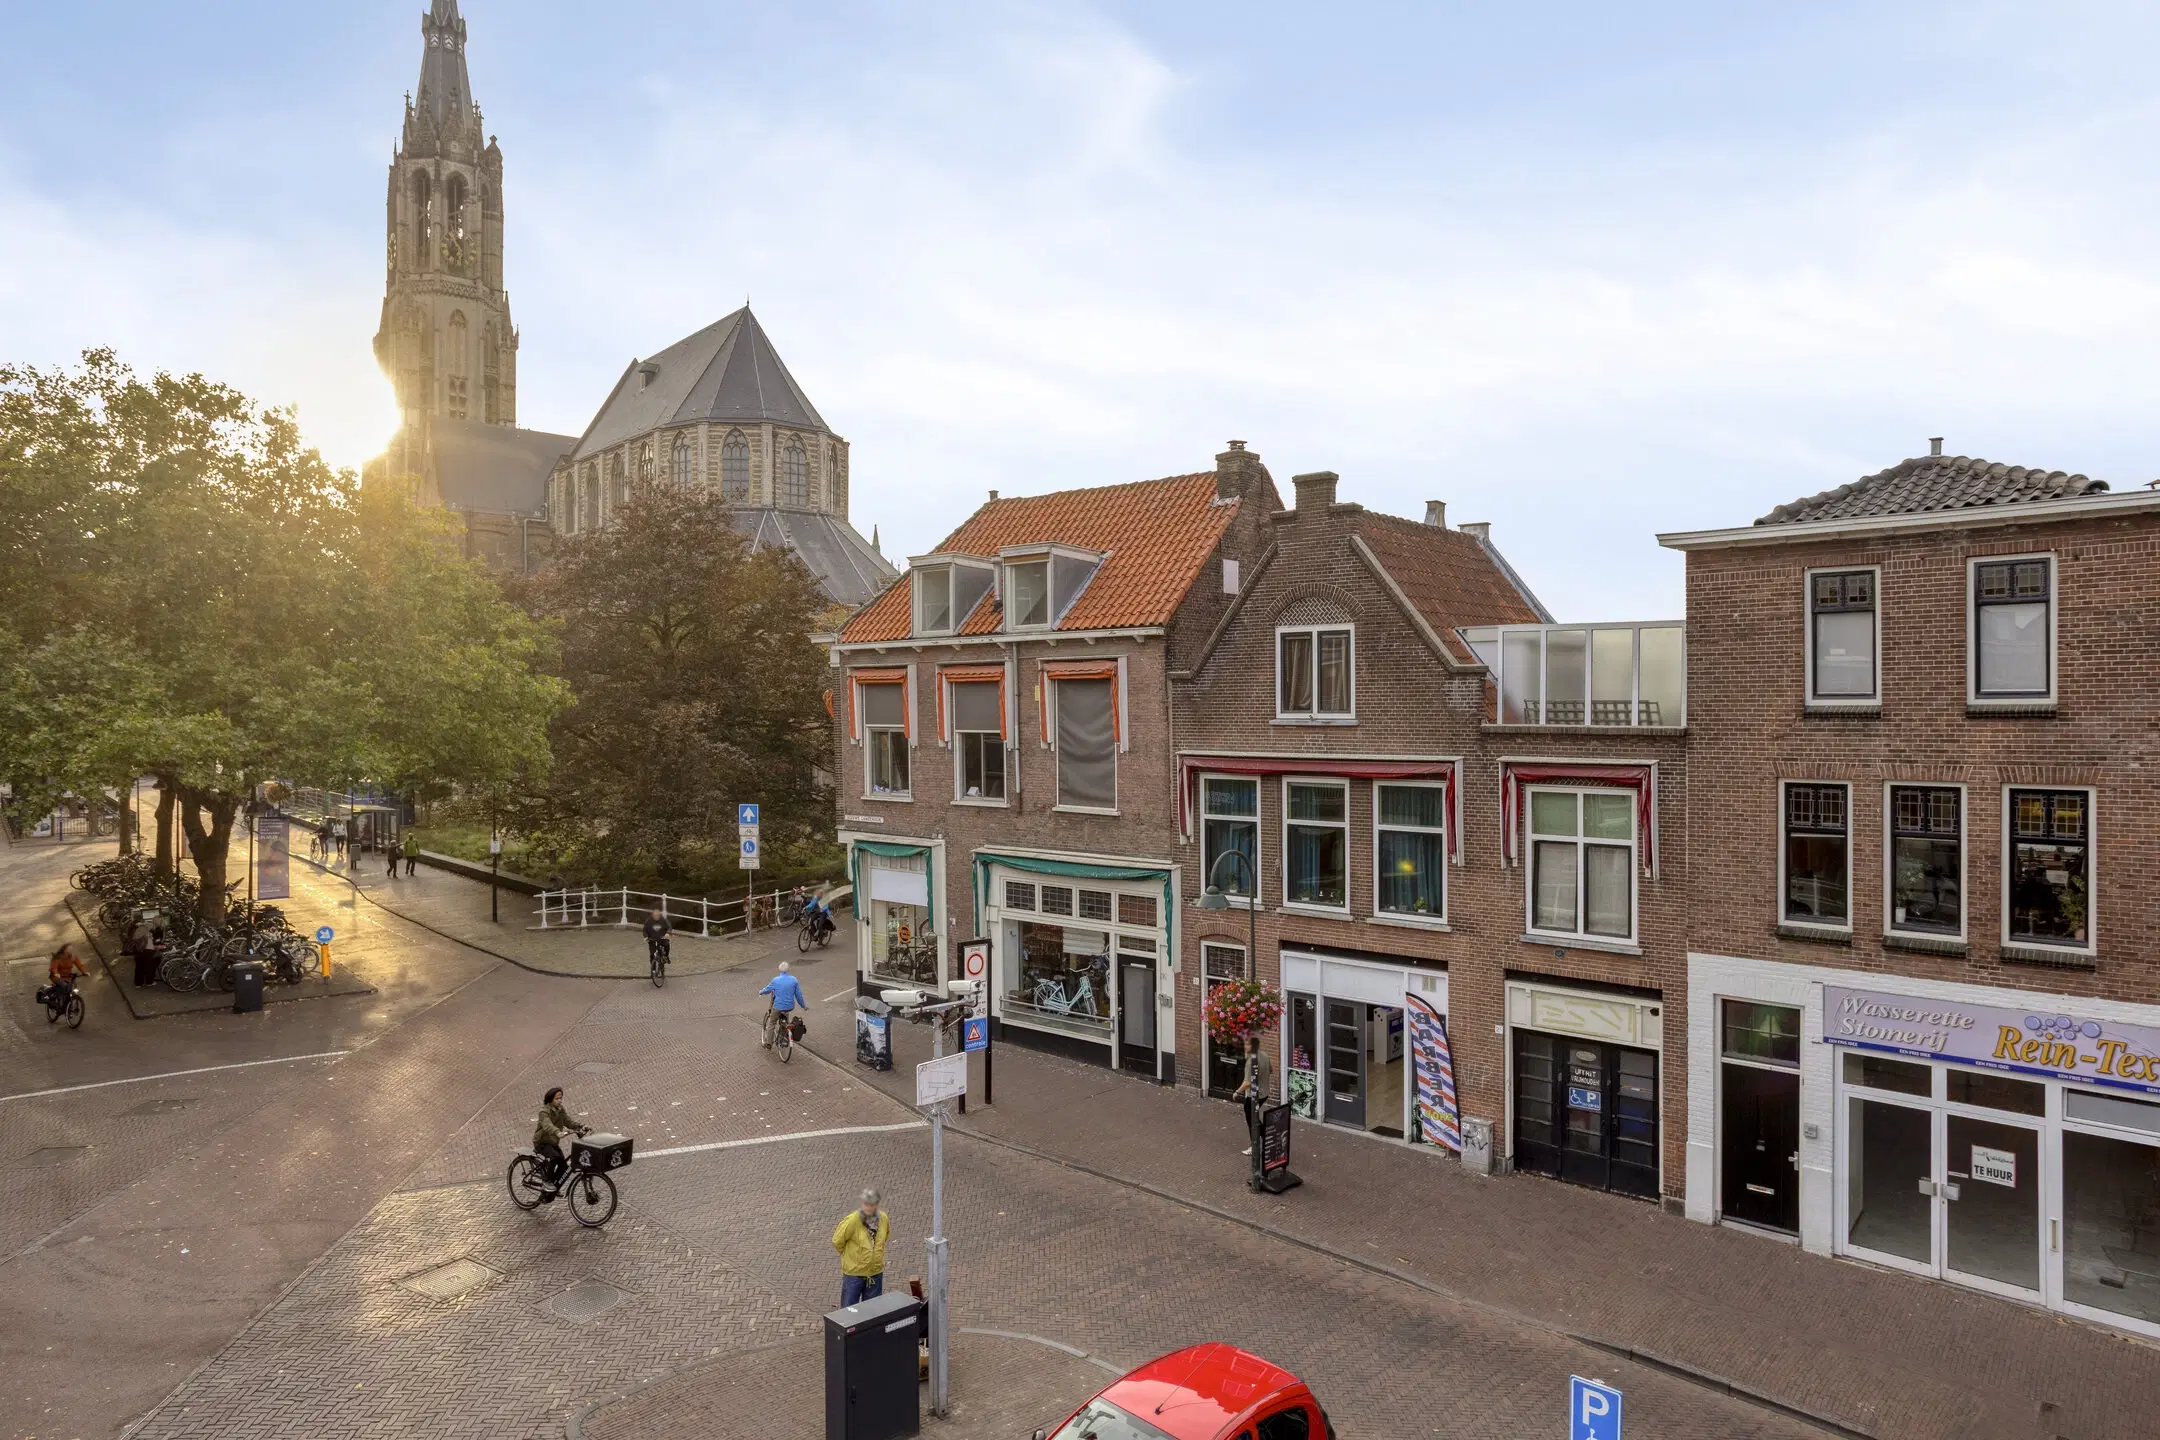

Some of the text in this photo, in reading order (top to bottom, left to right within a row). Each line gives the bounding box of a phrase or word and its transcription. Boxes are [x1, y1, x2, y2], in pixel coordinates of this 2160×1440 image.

[1841, 995, 1975, 1030] Wasserette
[1840, 1017, 1948, 1052] Stomerij
[1991, 1025, 2160, 1081] Rein-Tex
[1586, 1091, 1597, 1103] P
[1974, 1164, 1985, 1175] TE
[1986, 1167, 2013, 1182] HUUR
[1582, 1387, 1610, 1426] P
